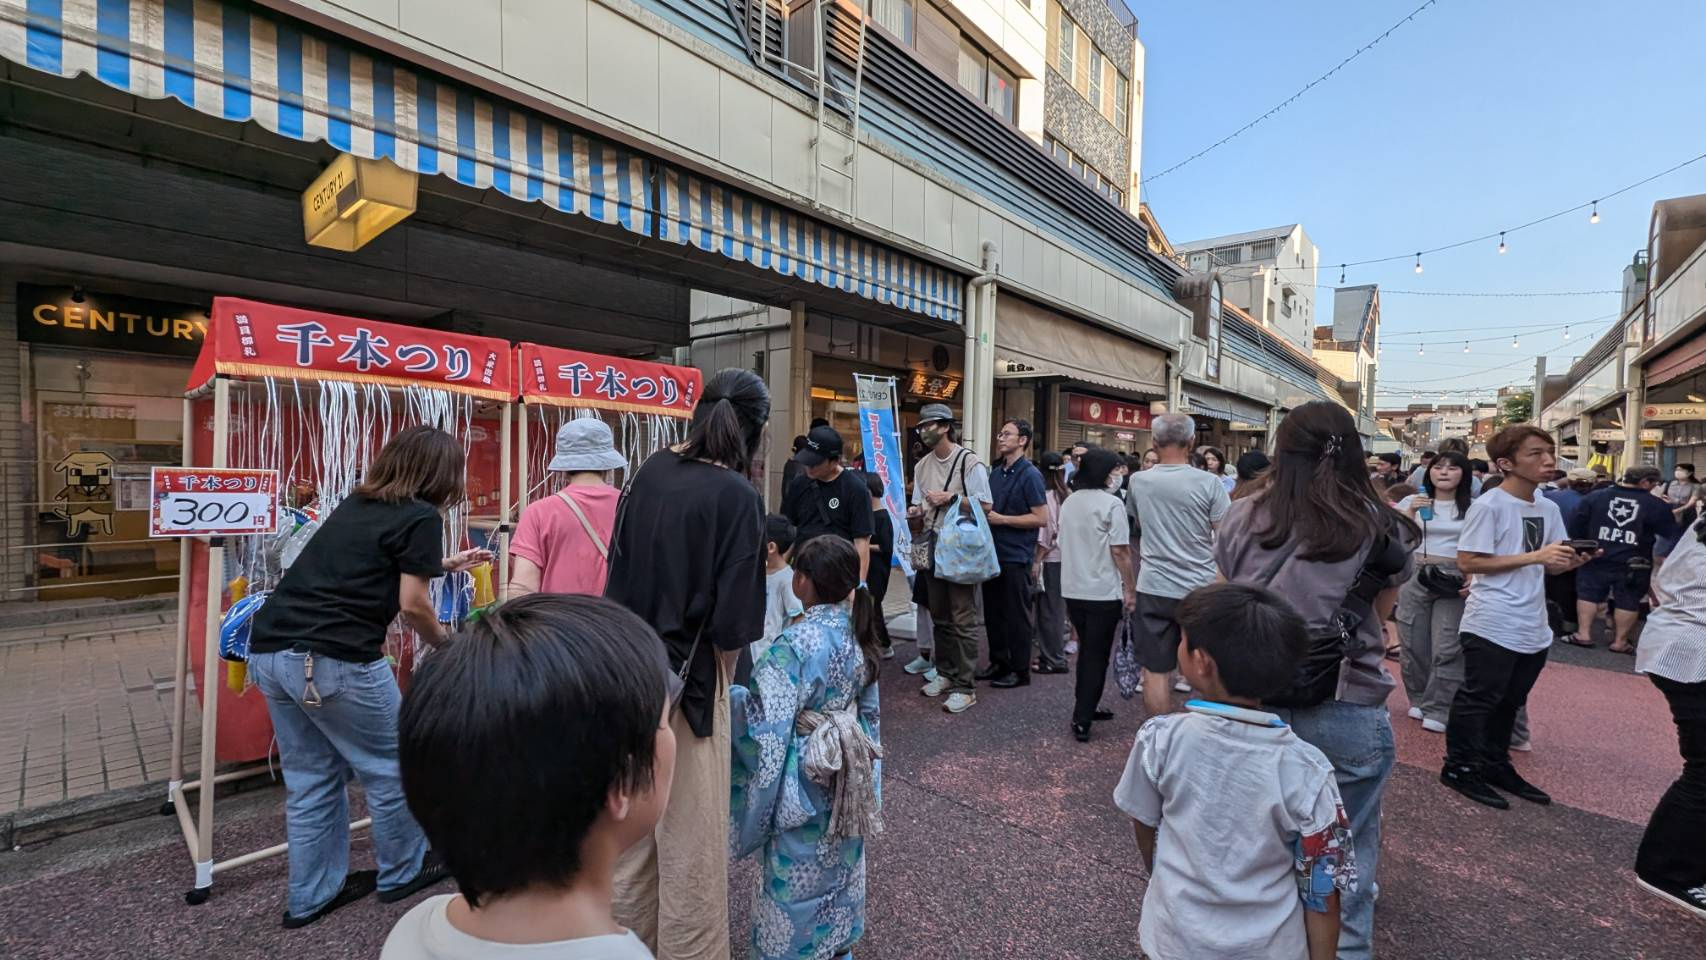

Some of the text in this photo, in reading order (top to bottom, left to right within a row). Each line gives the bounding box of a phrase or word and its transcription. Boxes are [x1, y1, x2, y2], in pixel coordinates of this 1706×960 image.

[313, 176, 338, 211] CENTURY
[276, 321, 471, 380] 千本つり
[558, 361, 679, 405] 千本つり
[178, 474, 257, 491] 千本つり
[172, 498, 249, 525] 300
[1598, 526, 1639, 546] R.P.D.
